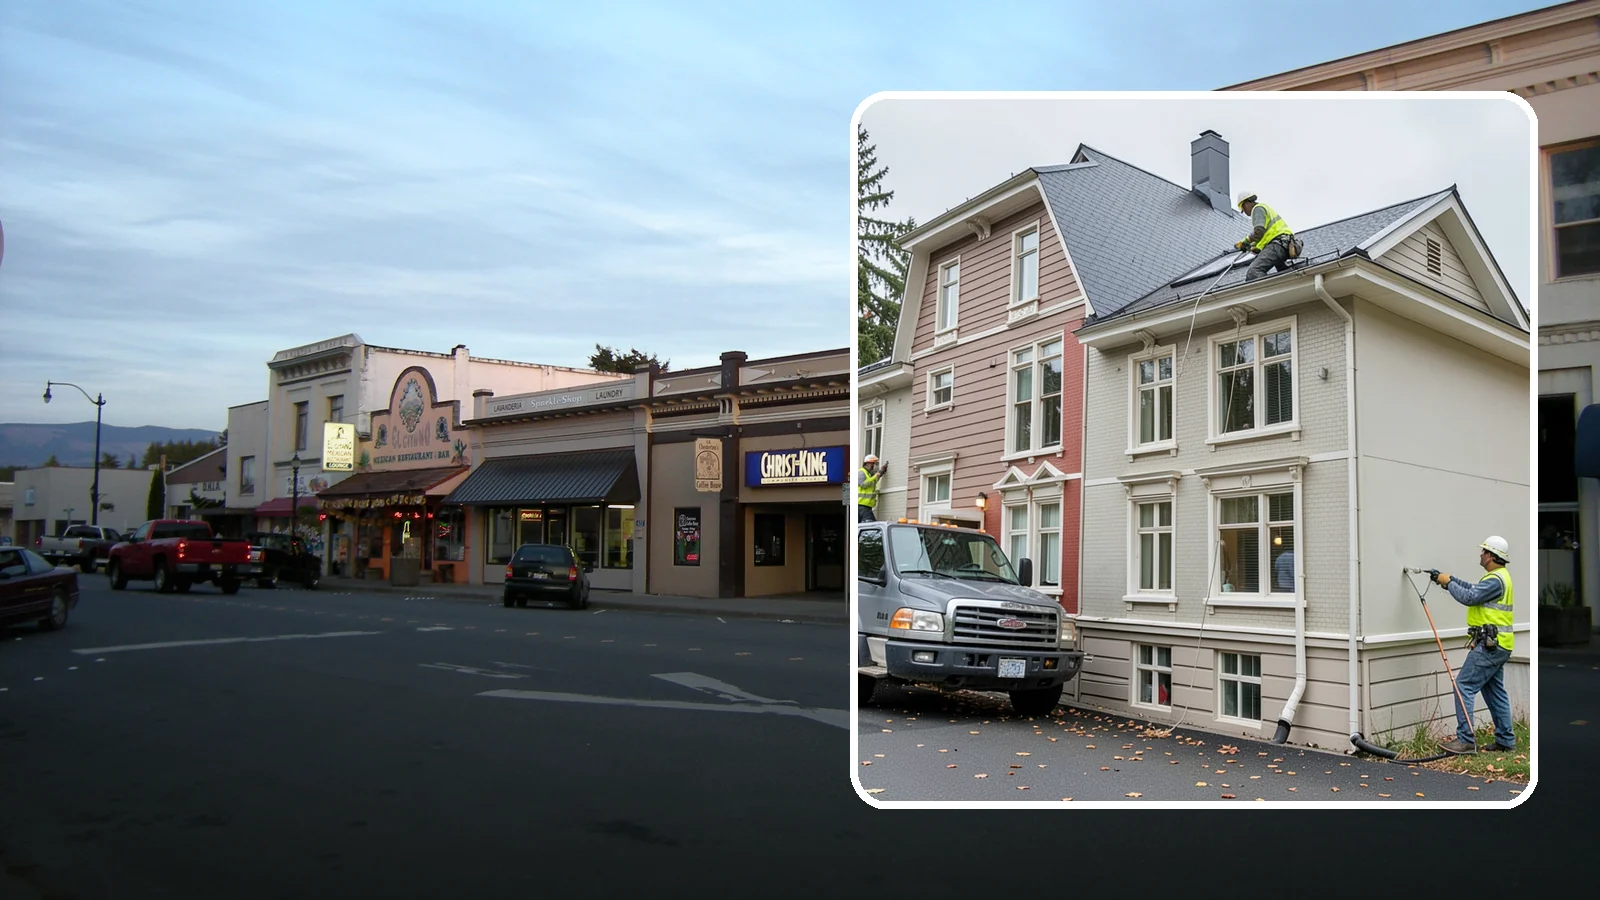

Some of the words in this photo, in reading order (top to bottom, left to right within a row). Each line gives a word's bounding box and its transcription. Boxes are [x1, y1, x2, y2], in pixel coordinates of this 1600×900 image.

[562, 394, 582, 404] Shop
[595, 389, 623, 399] LAUNDRY
[493, 402, 522, 412] LAVANDERIA
[397, 451, 433, 462] RESTAURANT
[438, 450, 450, 459] BAR
[761, 452, 797, 477] CHRIST
[799, 450, 827, 476] KING
